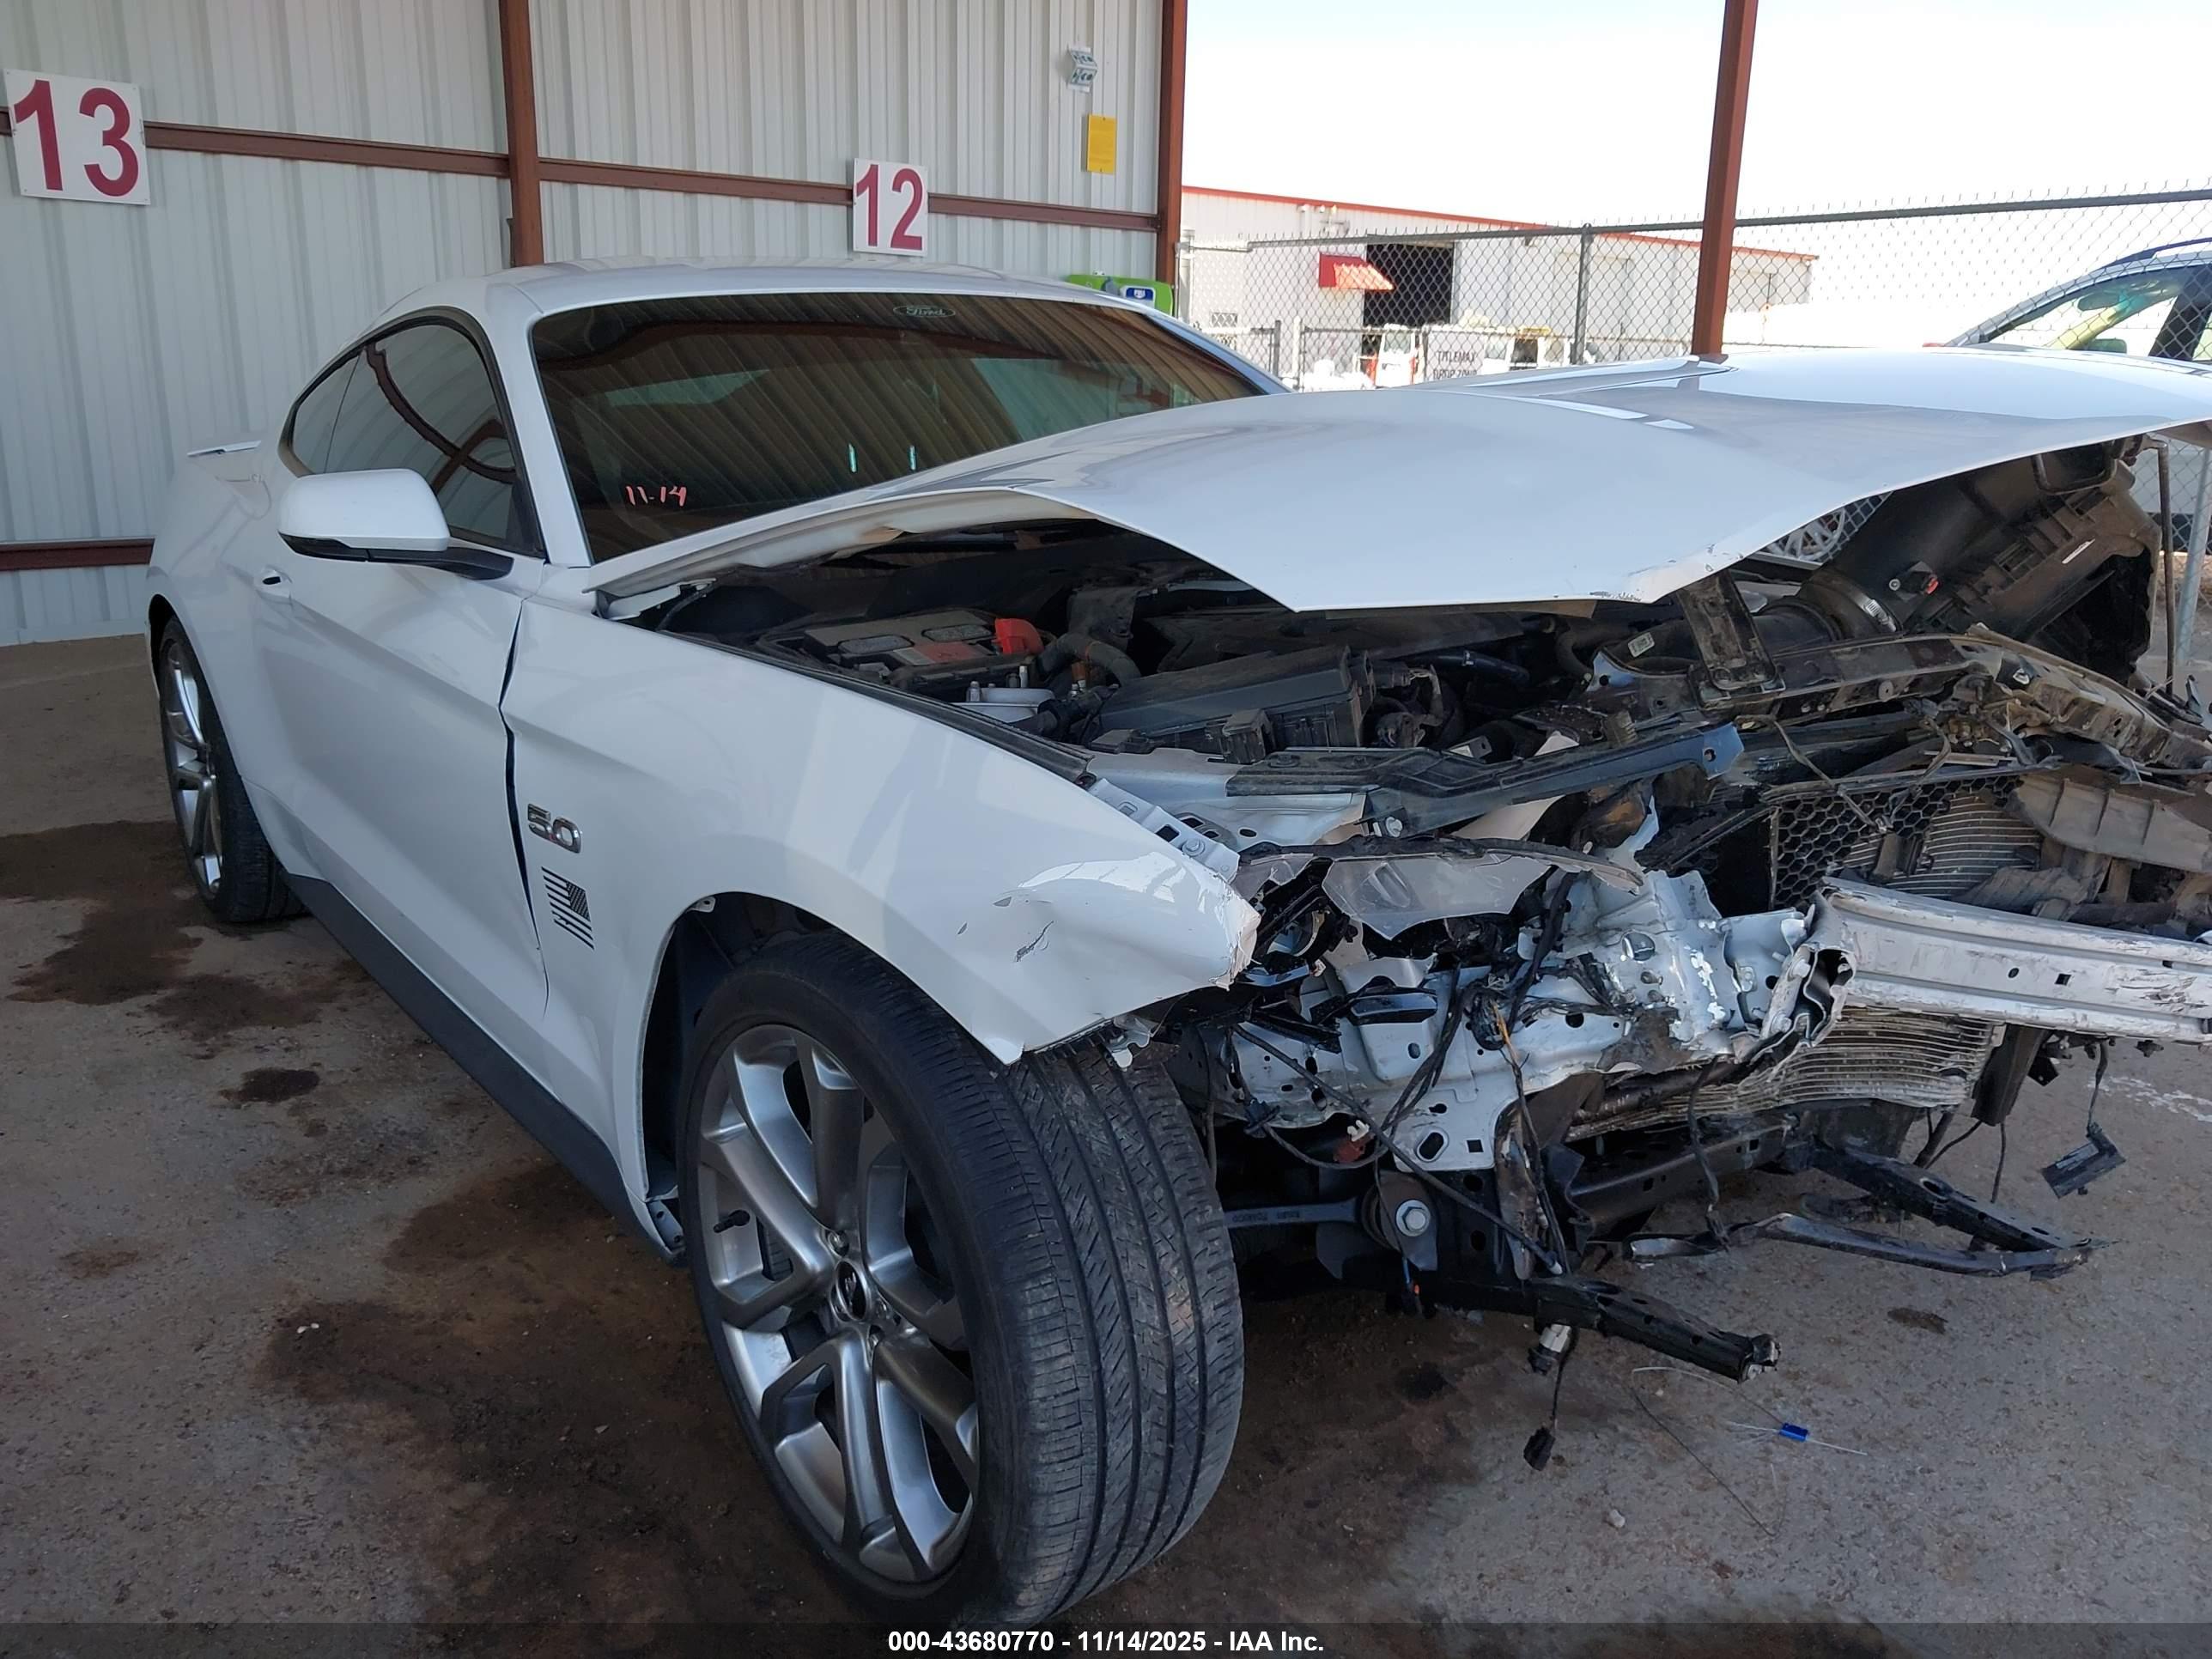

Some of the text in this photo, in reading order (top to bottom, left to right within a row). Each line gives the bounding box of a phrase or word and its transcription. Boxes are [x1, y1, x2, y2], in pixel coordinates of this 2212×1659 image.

[15, 80, 139, 197] 13
[856, 164, 923, 250] 12
[904, 306, 947, 317] Ford
[625, 486, 687, 507] 11-14
